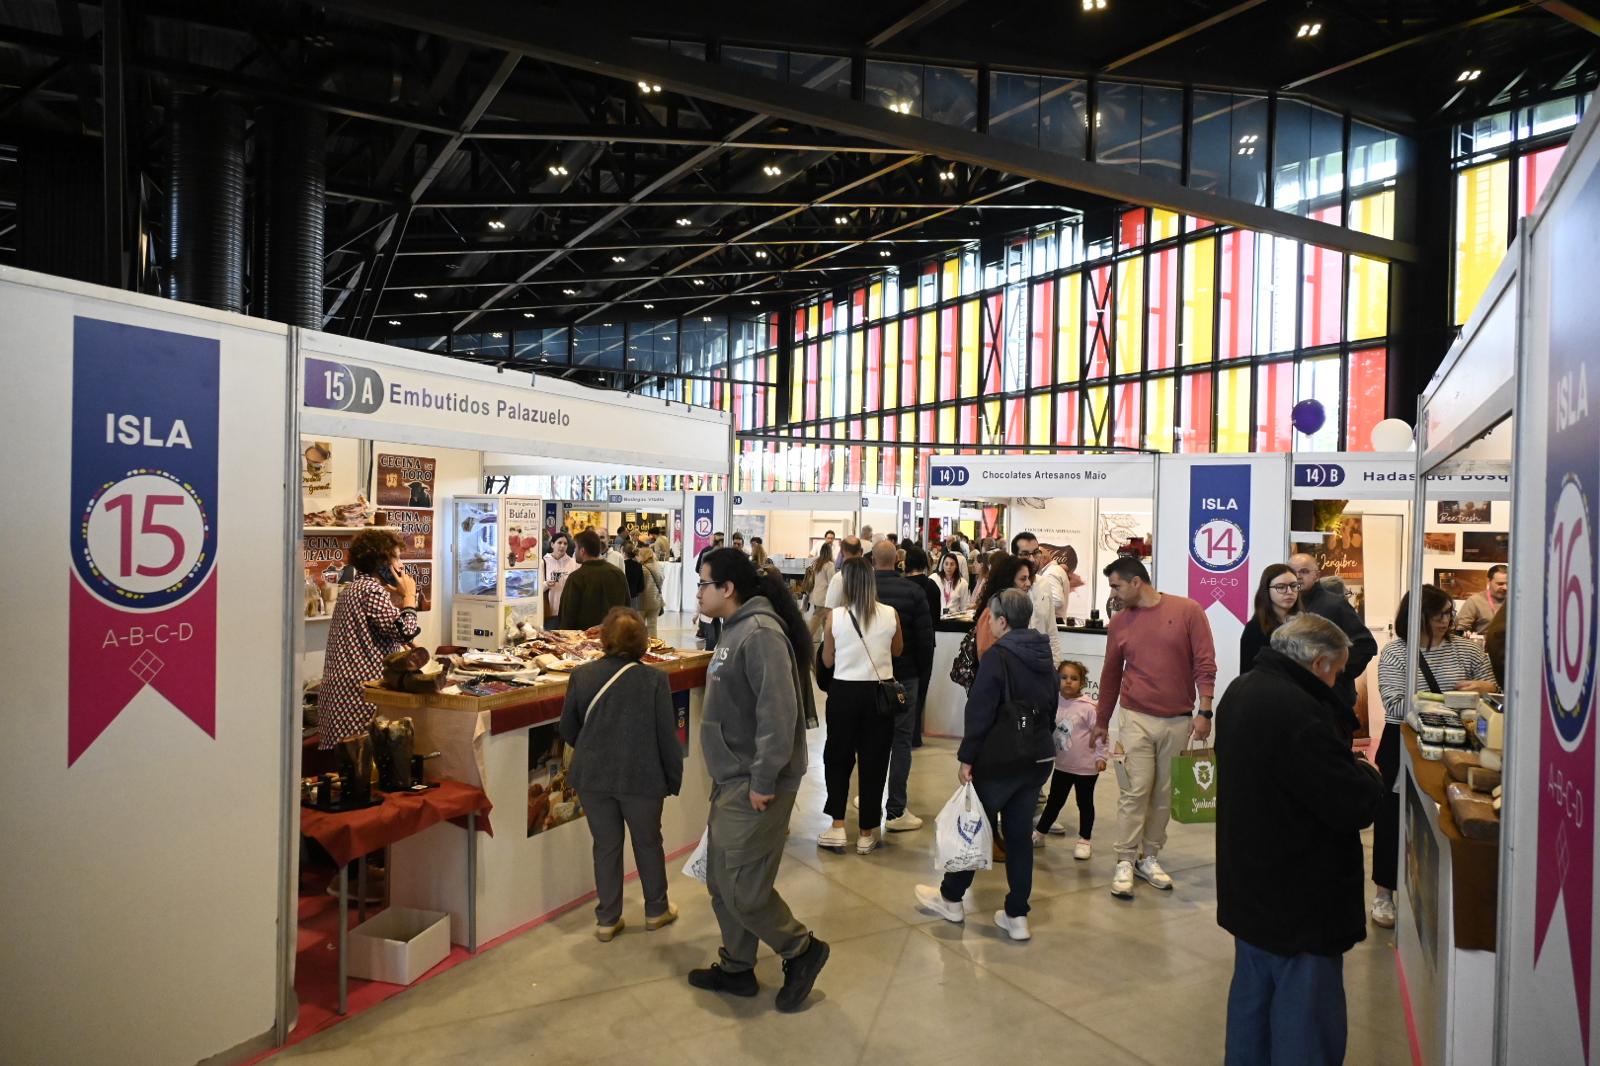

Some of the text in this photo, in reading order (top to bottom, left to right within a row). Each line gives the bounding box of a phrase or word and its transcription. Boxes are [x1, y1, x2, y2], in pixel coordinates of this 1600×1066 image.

[324, 370, 570, 427] 15 A Embutidos Palazuelo
[1555, 361, 1588, 433] ISLA
[105, 412, 193, 449] ISLA
[380, 455, 422, 470] CECINA
[401, 469, 433, 481] TORO
[939, 470, 950, 481] 14
[958, 470, 964, 481] D
[982, 470, 1032, 479] Chocolates
[1034, 471, 1081, 480] Artesanos
[1305, 468, 1319, 482] 14
[1330, 468, 1339, 482] B
[1363, 471, 1415, 481] Hadas
[1202, 498, 1238, 510] ISLA
[387, 511, 420, 523] ECINA
[509, 508, 536, 520] Bufalo
[698, 519, 709, 534] 12
[103, 494, 186, 578] 15
[1201, 527, 1238, 560] 14
[1554, 517, 1584, 684] 16
[102, 622, 194, 649] A-B-C-D
